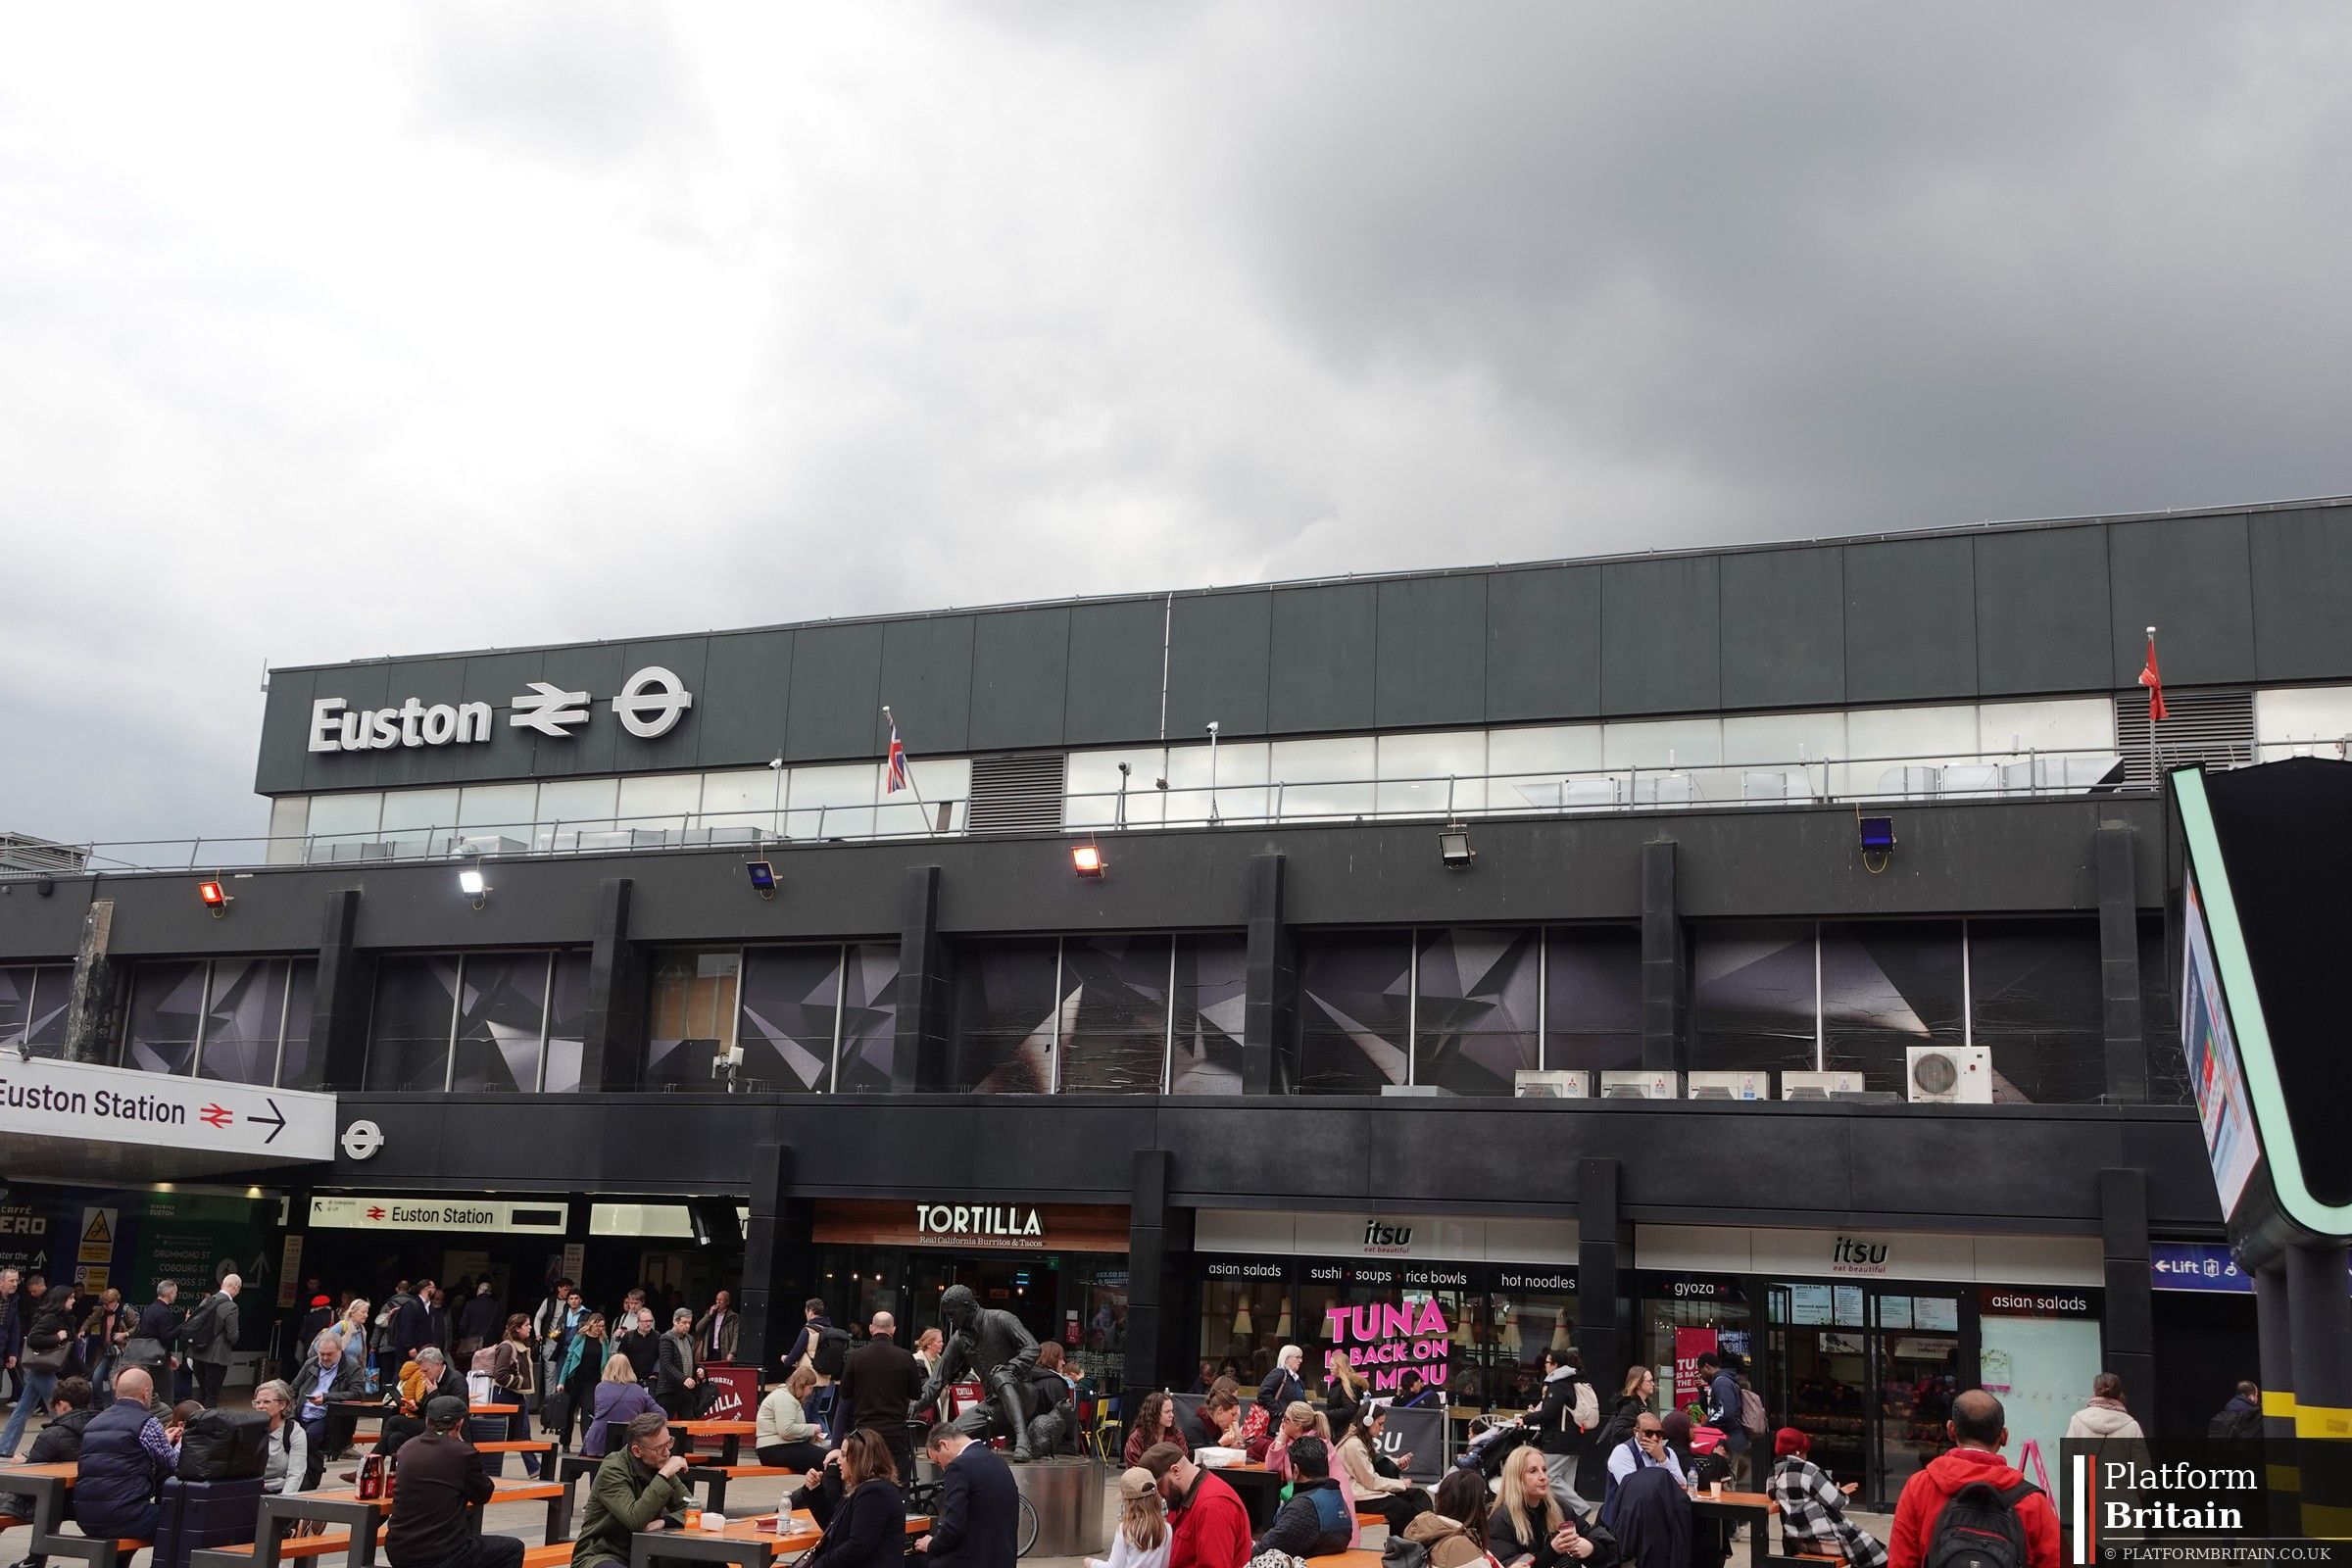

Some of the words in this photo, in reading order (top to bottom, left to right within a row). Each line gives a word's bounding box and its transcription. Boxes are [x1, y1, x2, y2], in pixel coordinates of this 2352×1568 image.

[309, 697, 492, 752] Euston
[93, 1091, 185, 1125] Station
[392, 1206, 439, 1223] Euston
[443, 1208, 493, 1225] Station
[916, 1204, 1042, 1236] TORTILLA
[0, 1216, 47, 1235] ERO
[1364, 1219, 1412, 1246] itsu
[937, 1236, 976, 1246] California
[977, 1238, 1011, 1248] Burritos
[1019, 1239, 1043, 1248] Tacos
[1377, 1246, 1410, 1254] beautiful
[1834, 1236, 1888, 1264] itsu
[0, 1251, 15, 1260] ter
[154, 1250, 200, 1260] DRUMMOND
[201, 1251, 211, 1260] ST
[159, 1263, 198, 1273] COBOURG
[199, 1265, 209, 1274] ST
[1208, 1263, 1240, 1275] asian
[1243, 1263, 1282, 1277] salads
[1848, 1264, 1886, 1273] beautiful
[2172, 1260, 2200, 1274] Lift
[197, 1278, 208, 1287] ST
[1310, 1266, 1342, 1279] sushi
[1355, 1269, 1392, 1283] soups
[1405, 1270, 1428, 1283] rice
[1431, 1270, 1467, 1285] bowls
[1501, 1273, 1521, 1287] hot
[1525, 1274, 1576, 1289] noodles
[1675, 1282, 1715, 1297] gyoza
[1992, 1295, 2033, 1308] asian
[2036, 1296, 2086, 1311] salads
[1326, 1297, 1448, 1344] TUNA
[1349, 1344, 1408, 1366] BACK
[1413, 1339, 1448, 1360] ON
[1677, 1358, 1698, 1371] TU
